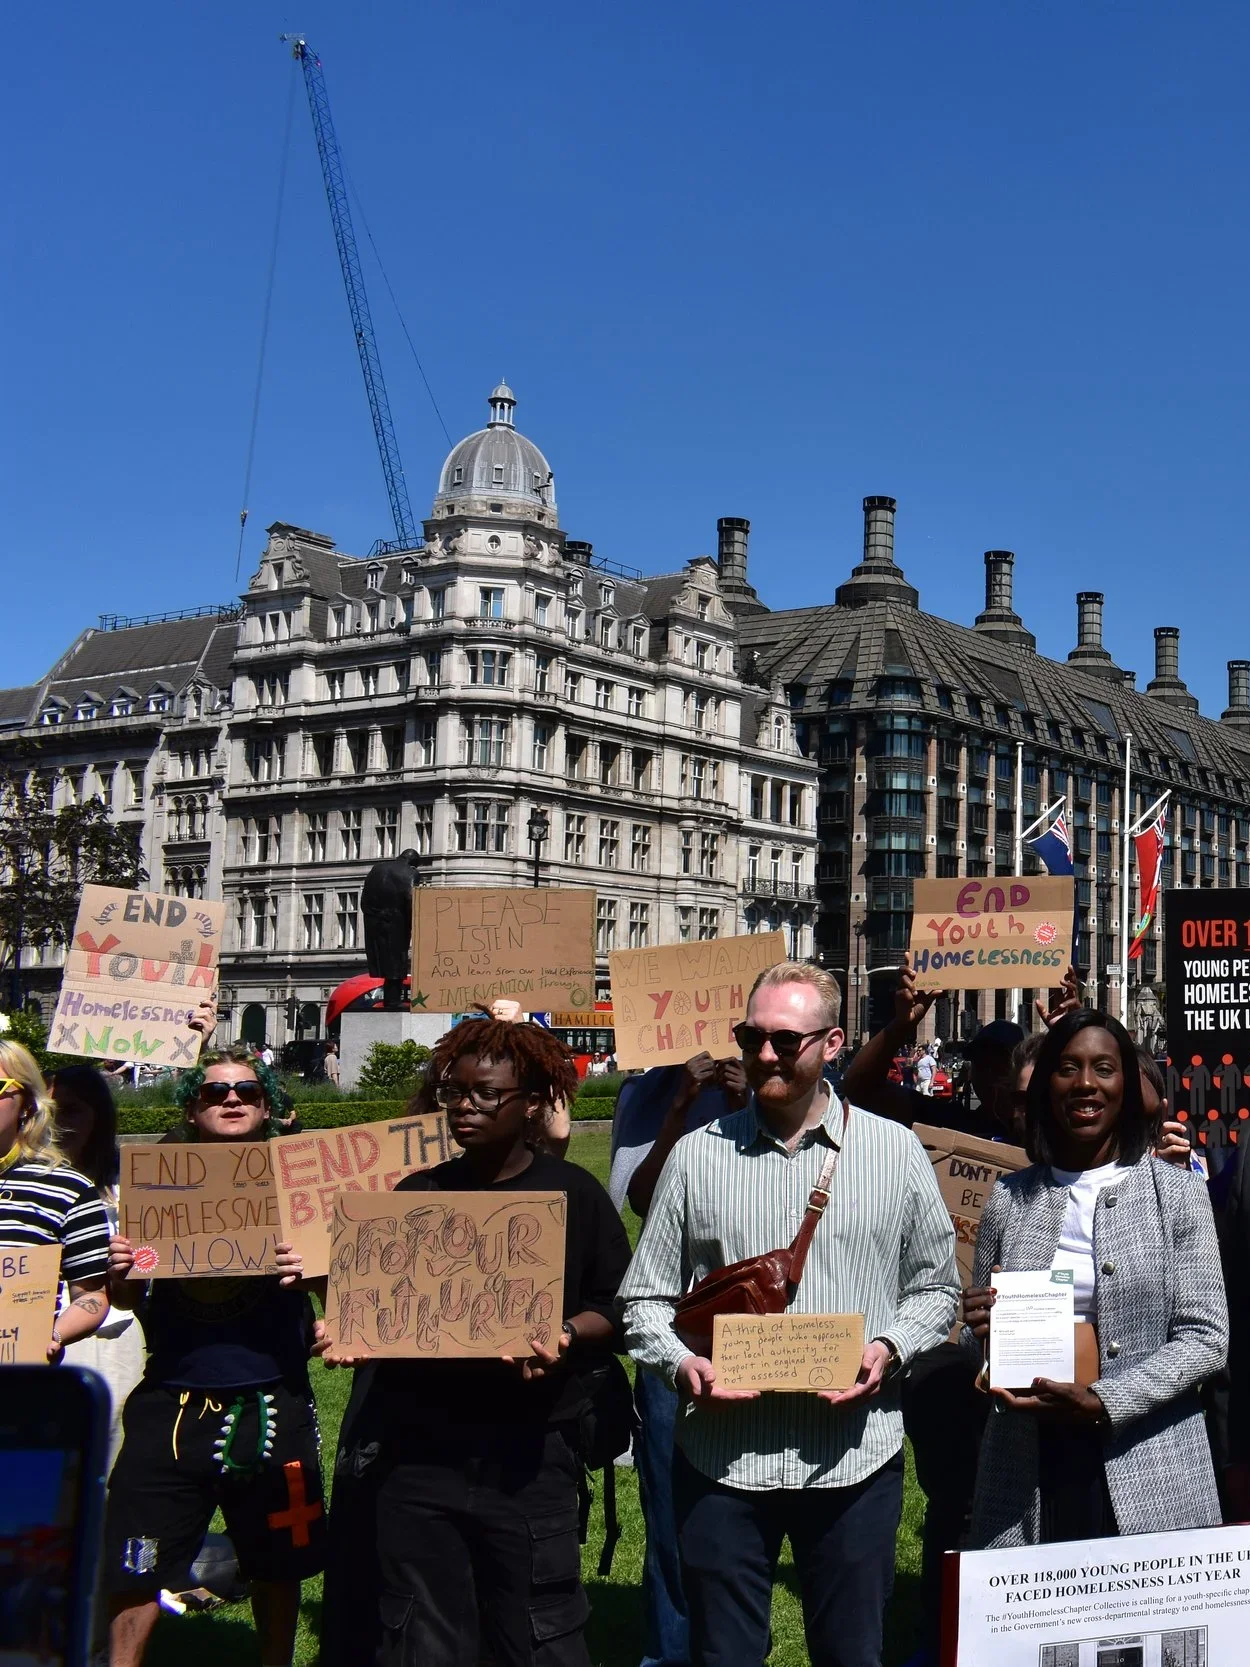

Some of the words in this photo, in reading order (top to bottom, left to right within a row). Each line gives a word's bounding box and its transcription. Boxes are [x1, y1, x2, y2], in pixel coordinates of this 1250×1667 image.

[123, 894, 186, 928] END
[436, 892, 562, 927] PLEASE
[434, 926, 524, 953] LISTEN
[1182, 920, 1237, 948] OVER
[431, 966, 461, 978] And
[467, 968, 491, 976] learn
[470, 954, 491, 965] US
[612, 952, 661, 988] WE
[676, 936, 779, 981] WANT
[1184, 960, 1229, 978] YOUNG
[438, 978, 534, 1007] INTERVENTION
[538, 976, 582, 990] Through
[622, 994, 637, 1022] A
[648, 984, 744, 1020] YOUTH
[1184, 1010, 1215, 1031] THE
[1219, 1009, 1241, 1029] UK
[638, 1018, 740, 1053] CHAPTE
[131, 1152, 207, 1186] END
[276, 1129, 381, 1189] END
[949, 1159, 992, 1182] DON'T
[960, 1189, 983, 1208] BE
[125, 1196, 280, 1243] HOMELESSNE
[997, 1292, 1067, 1300] #YouthHomelessChapter
[722, 1324, 732, 1338] A
[736, 1323, 765, 1335] third
[791, 1318, 836, 1330] homeless
[722, 1340, 750, 1351] young
[758, 1335, 782, 1349] people
[788, 1332, 808, 1341] who
[813, 1328, 852, 1342] approach
[720, 1352, 739, 1361] their
[744, 1350, 765, 1359] local
[770, 1344, 817, 1357] authority
[824, 1342, 839, 1352] for
[774, 1358, 806, 1369] england
[813, 1356, 839, 1364] were
[724, 1375, 743, 1384] not
[751, 1368, 798, 1381] assessed
[989, 1574, 1029, 1587] OVER
[1034, 1568, 1077, 1583] 118,000
[1081, 1563, 1130, 1578] YOUNG
[1134, 1556, 1186, 1572] PEOPLE
[1189, 1555, 1203, 1566] IN
[1206, 1551, 1233, 1564] THE
[1005, 1588, 1051, 1604] FACED
[1055, 1576, 1164, 1598] HOMELESSNESS
[1168, 1572, 1202, 1586] LAST
[1204, 1568, 1241, 1581] YEAR
[1002, 1605, 1092, 1621] #YouthHomelessChapter
[1093, 1601, 1130, 1611] Collective
[1132, 1598, 1138, 1606] is
[1140, 1596, 1164, 1606] calling
[1165, 1594, 1176, 1602] for
[1183, 1589, 1232, 1603] youth-specific
[1000, 1624, 1012, 1632] the
[1013, 1619, 1065, 1631] Government's
[1067, 1616, 1081, 1625] new
[1083, 1608, 1151, 1623] cross-departmental
[1152, 1606, 1180, 1615] strategy
